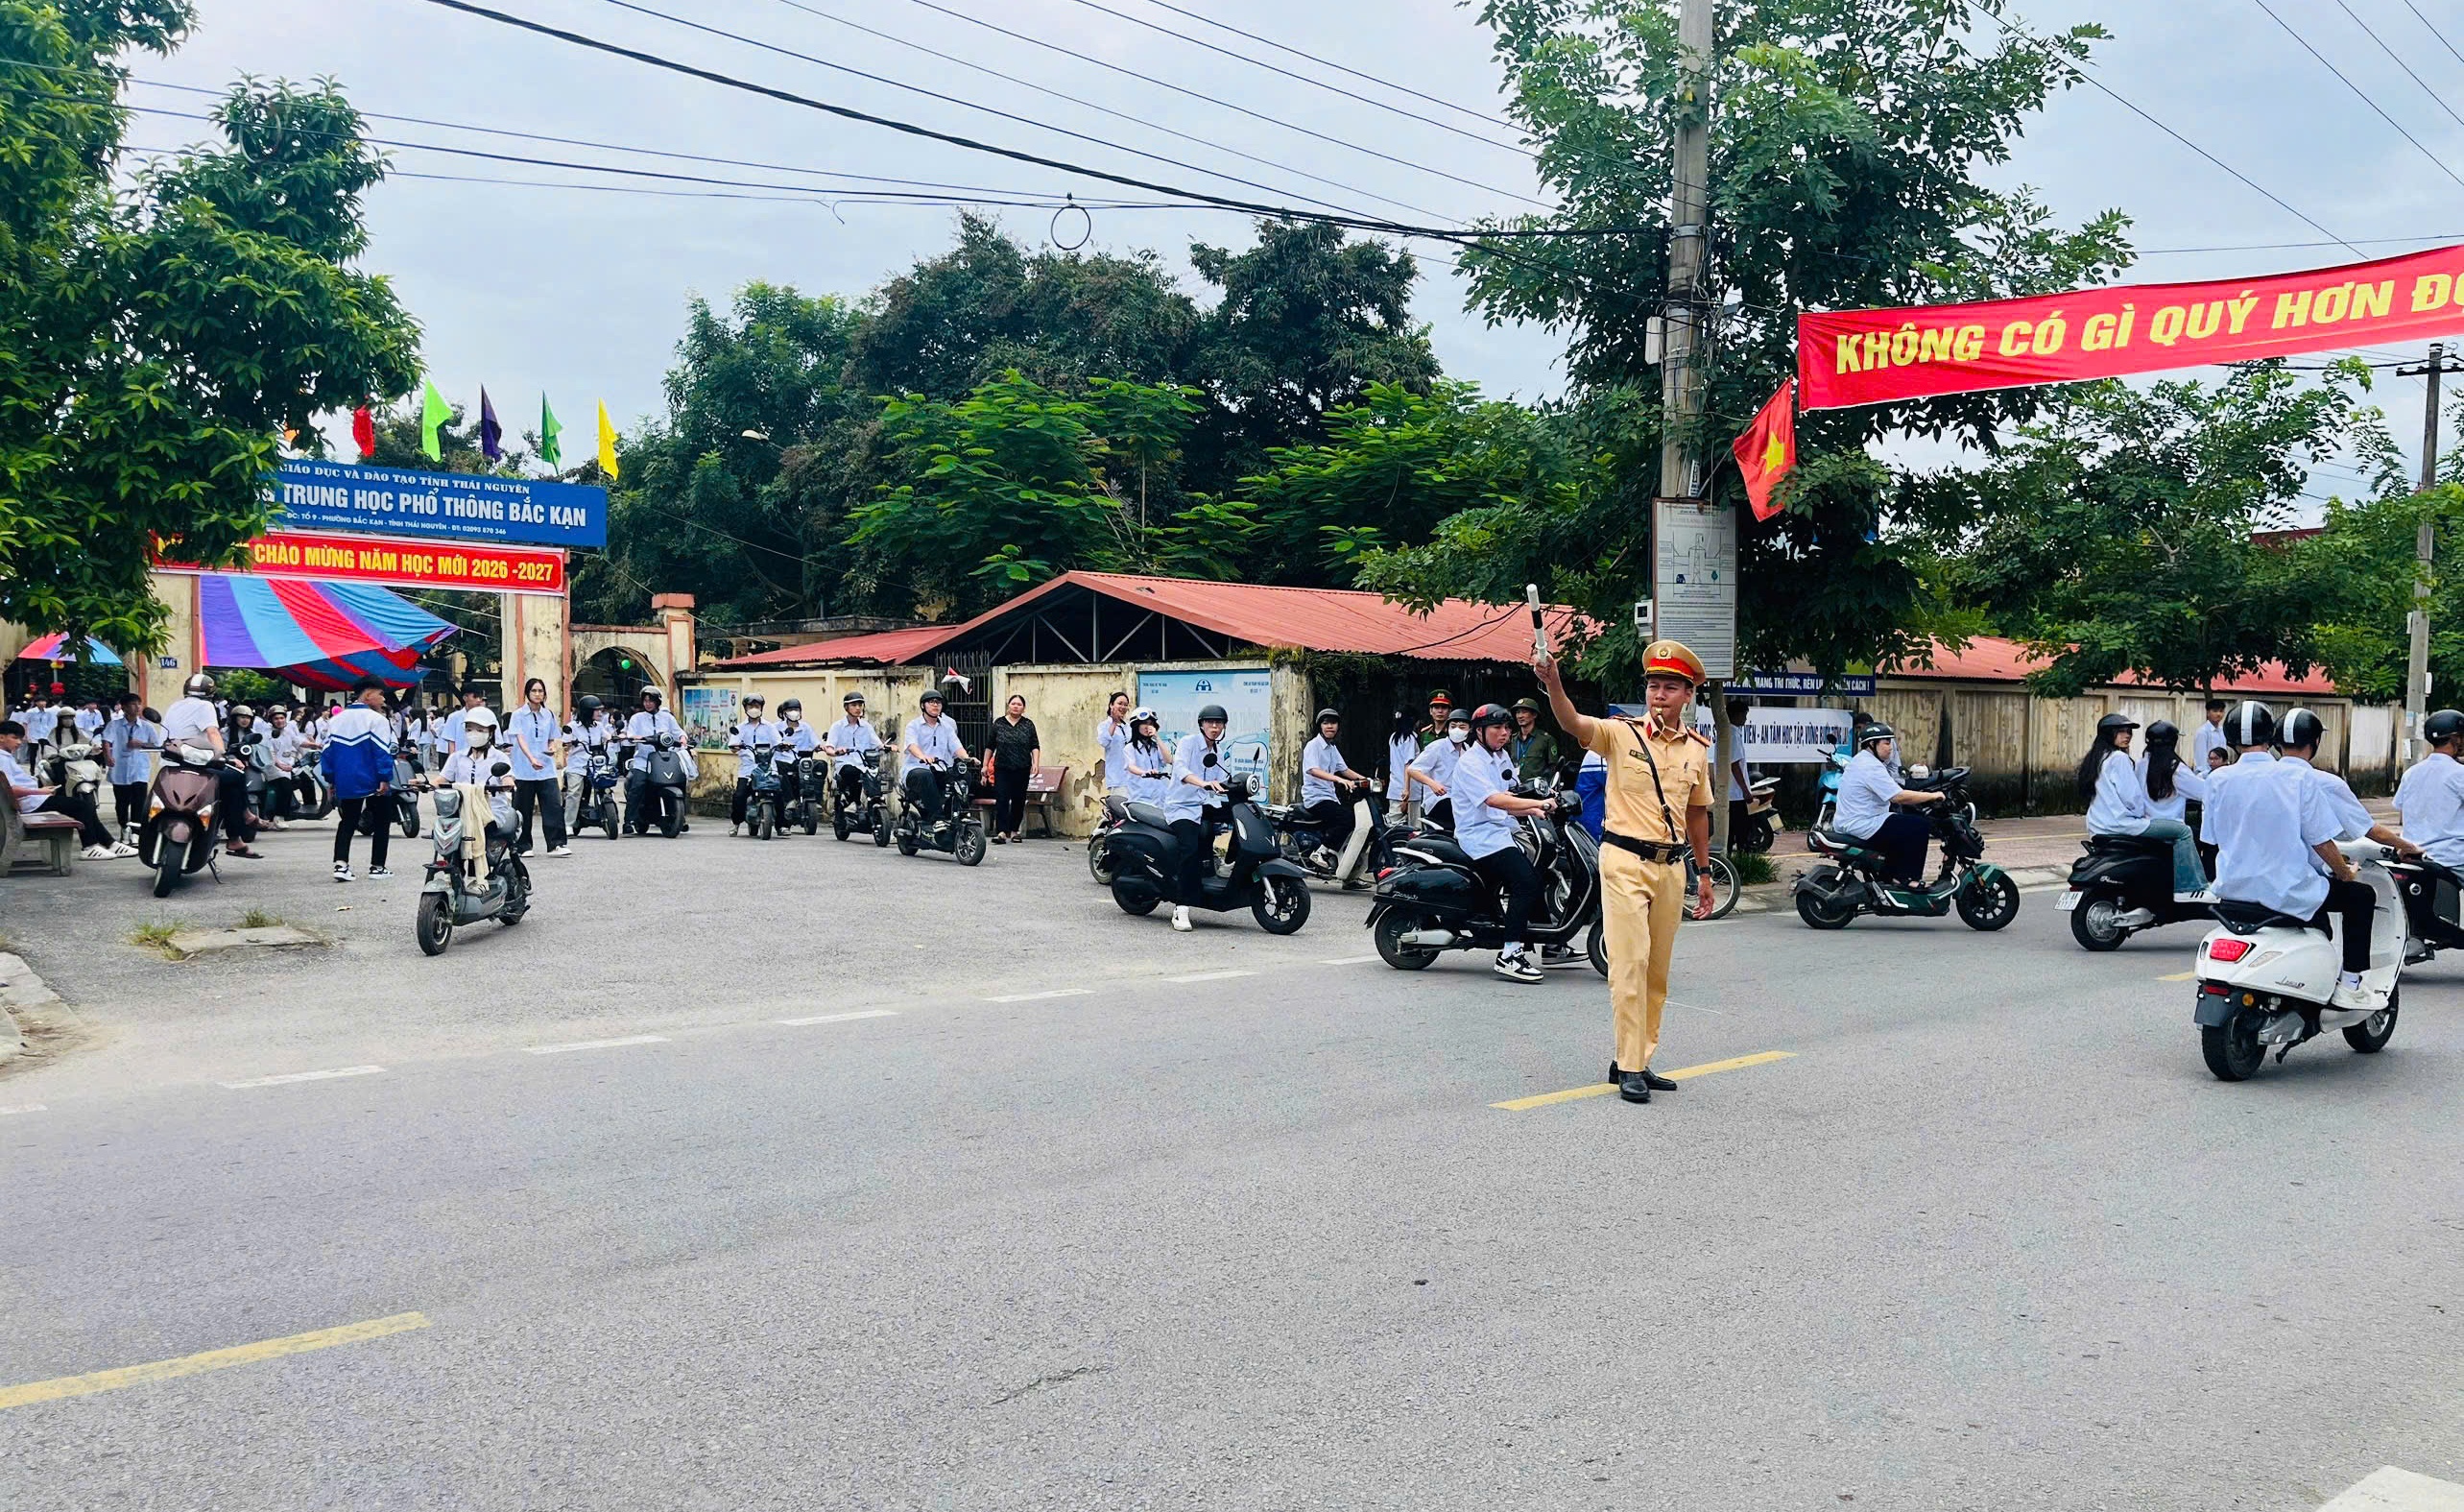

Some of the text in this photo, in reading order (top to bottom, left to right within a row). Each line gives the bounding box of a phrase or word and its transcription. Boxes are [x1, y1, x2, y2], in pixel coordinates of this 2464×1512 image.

[1837, 323, 1985, 374] KHÔNG
[1998, 310, 2067, 357] CÓ
[2080, 302, 2136, 352] GÌ
[2149, 290, 2260, 347] QUÝ
[2271, 279, 2395, 329] HƠN
[314, 467, 340, 478] DỤC
[344, 469, 360, 479] VÀ
[364, 471, 389, 482] ĐÀO
[393, 473, 417, 485] TẠO
[452, 480, 480, 491] THÁI
[484, 482, 530, 494] NGUYÊN
[283, 483, 348, 508] TRUNG
[354, 490, 394, 516] HỌC
[398, 488, 439, 516] PHỔ
[443, 493, 504, 520] THÔNG
[509, 496, 545, 524] BẮC
[550, 506, 586, 530] KẠN
[254, 541, 300, 564] CHÀO
[304, 544, 355, 568] MỪNG
[359, 548, 397, 572] NĂM
[401, 553, 433, 577] HỌC
[438, 554, 467, 576] MỚI
[471, 559, 509, 578] 2026
[512, 562, 554, 582] -2027
[161, 659, 176, 667] 146
